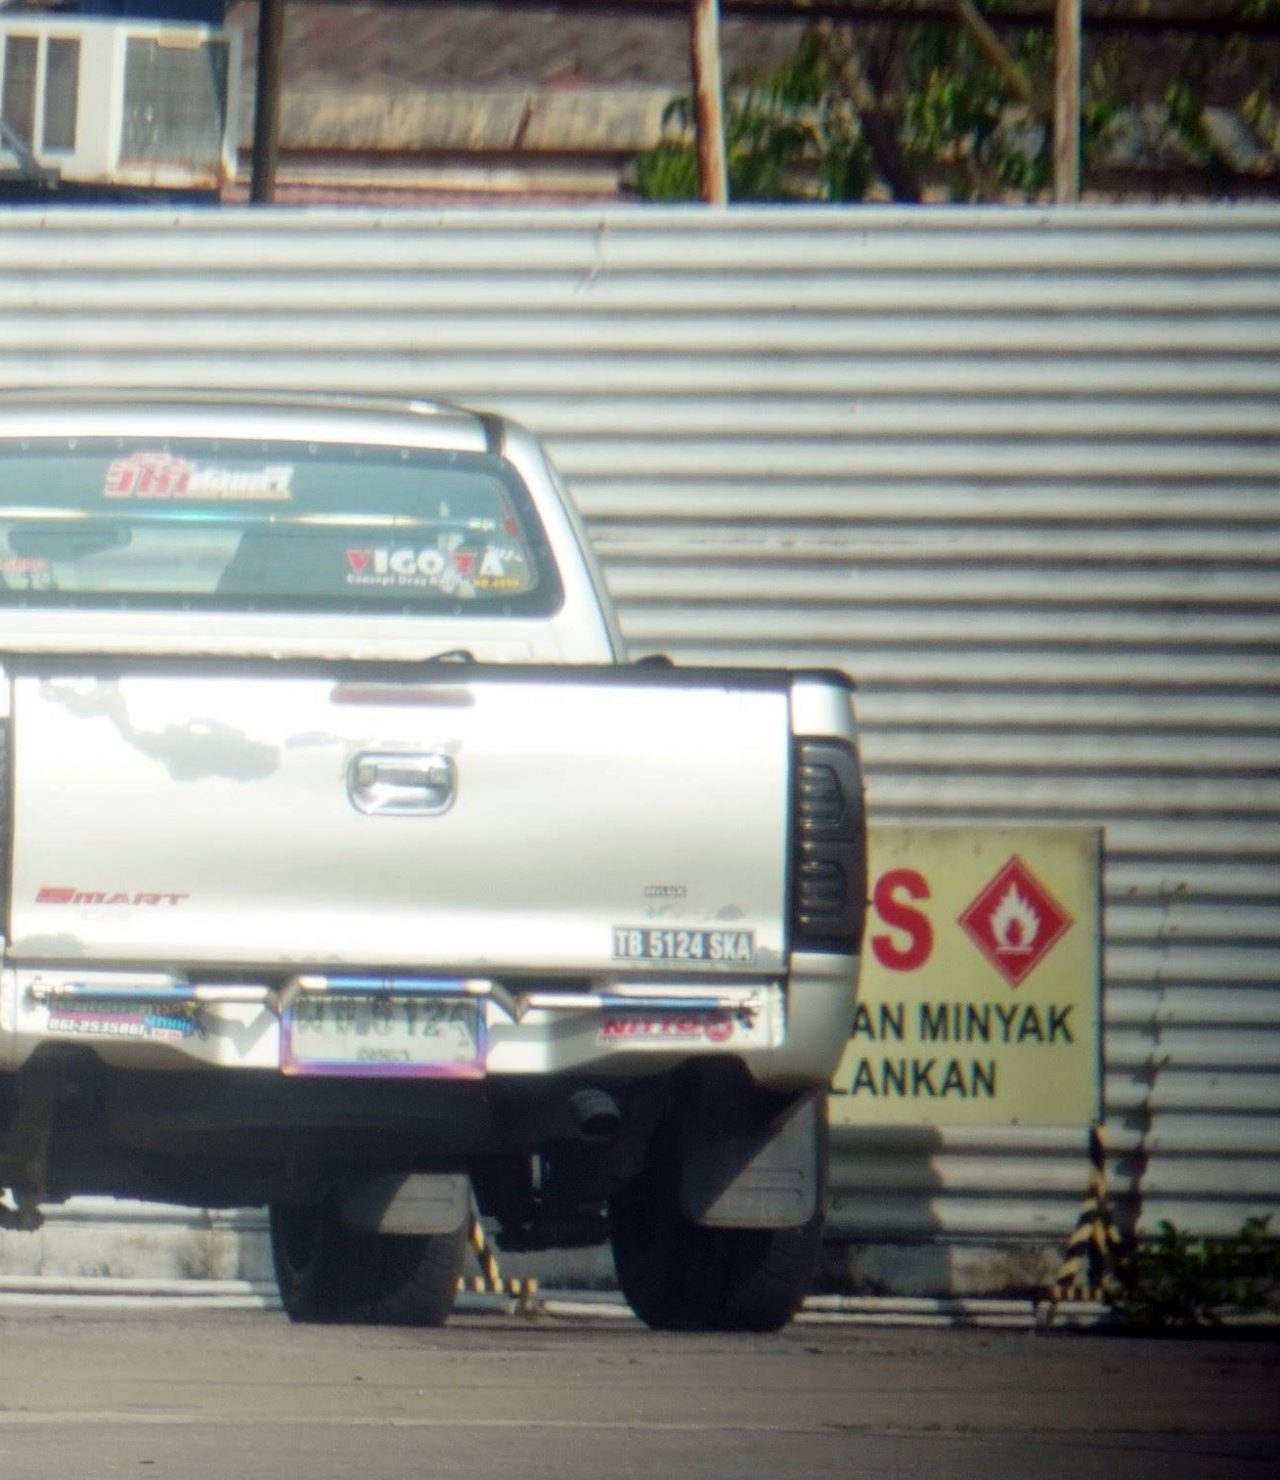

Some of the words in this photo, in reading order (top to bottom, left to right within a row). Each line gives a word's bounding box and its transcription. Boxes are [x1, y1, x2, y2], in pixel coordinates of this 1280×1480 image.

[615, 931, 643, 957] TB
[649, 931, 704, 959] 5124
[710, 931, 751, 960] SKA
[920, 1002, 1074, 1043] MINYAK
